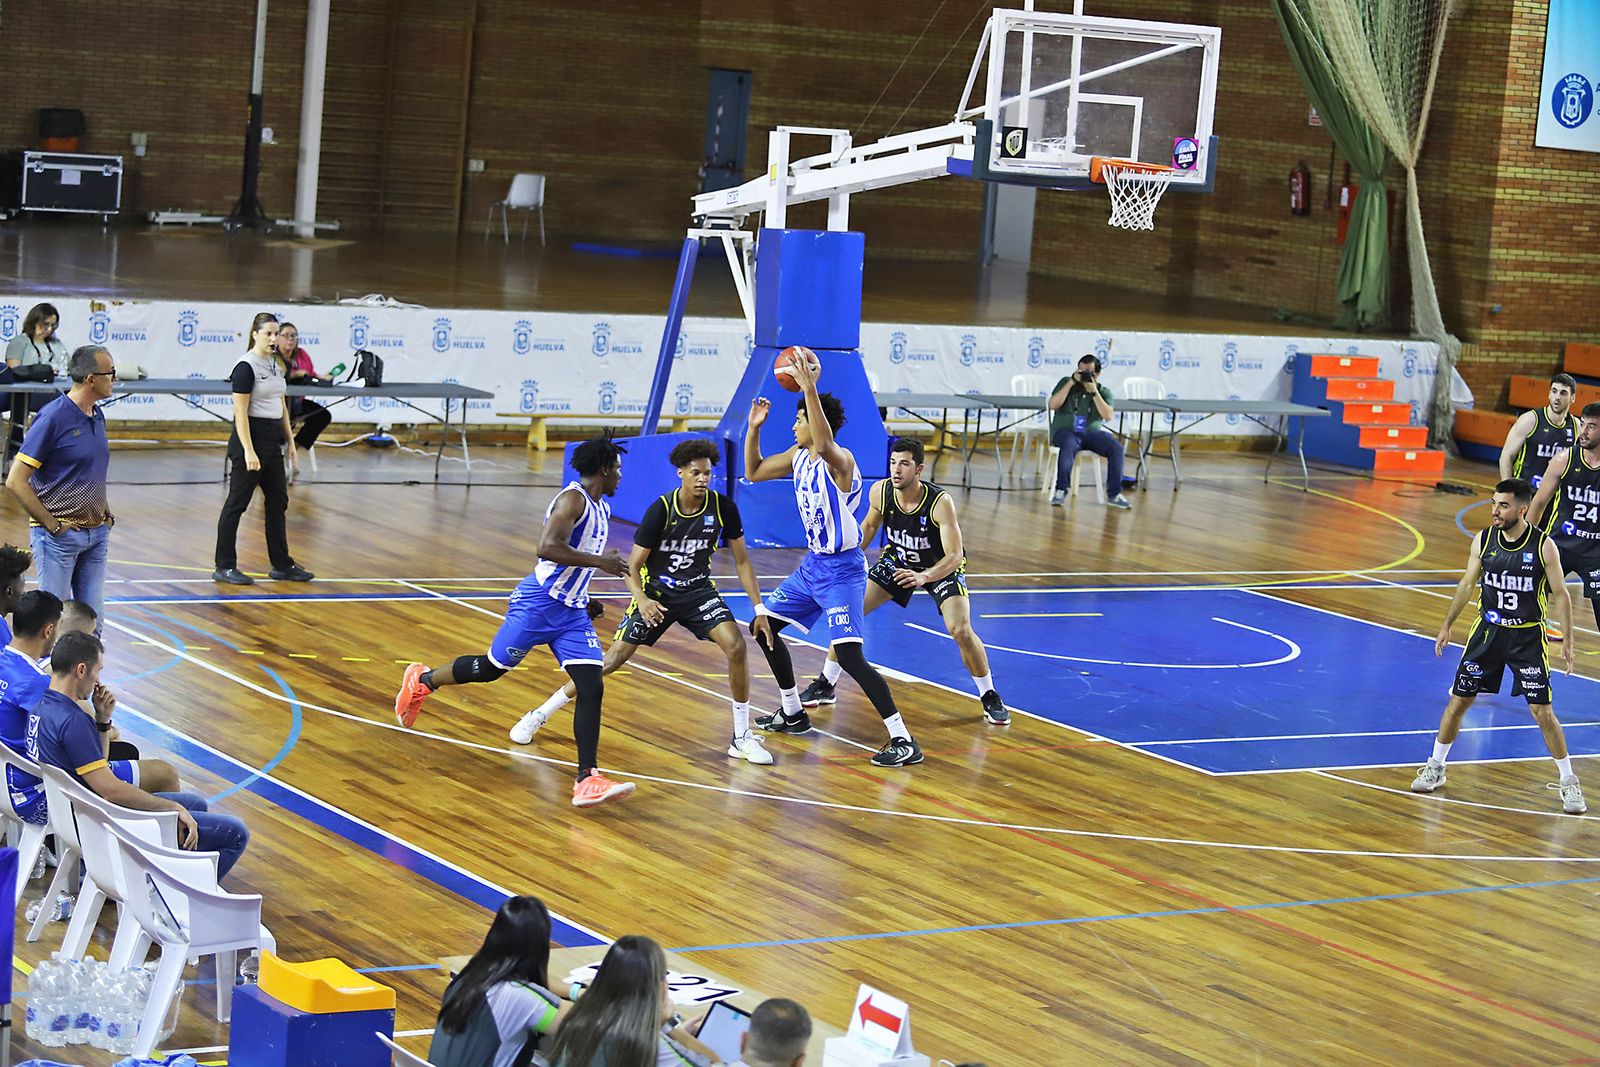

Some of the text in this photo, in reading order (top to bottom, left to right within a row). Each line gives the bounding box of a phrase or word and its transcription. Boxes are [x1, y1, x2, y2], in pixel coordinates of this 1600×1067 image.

[112, 332, 147, 341] HUELVA
[200, 335, 235, 343] HUELVA
[297, 337, 320, 345] ELVA
[371, 339, 404, 347] HUELVA
[453, 341, 486, 349] HUELVA
[533, 343, 565, 351] HUELVA
[612, 345, 643, 354] HUELVA
[688, 347, 718, 356] HUELVA
[907, 353, 936, 361] HUELVA
[1044, 357, 1072, 365] HUELVA
[1111, 359, 1137, 367] HUELVA
[1175, 360, 1200, 368] HUELVA
[1238, 362, 1263, 370] HUELVA
[208, 397, 234, 405] HUELV
[540, 403, 571, 411] HUELVA
[694, 406, 724, 414] HUELVA
[1573, 503, 1599, 524] 24
[668, 553, 695, 573] 35
[1484, 570, 1534, 592] LLÍRIA
[1497, 591, 1519, 611] 13
